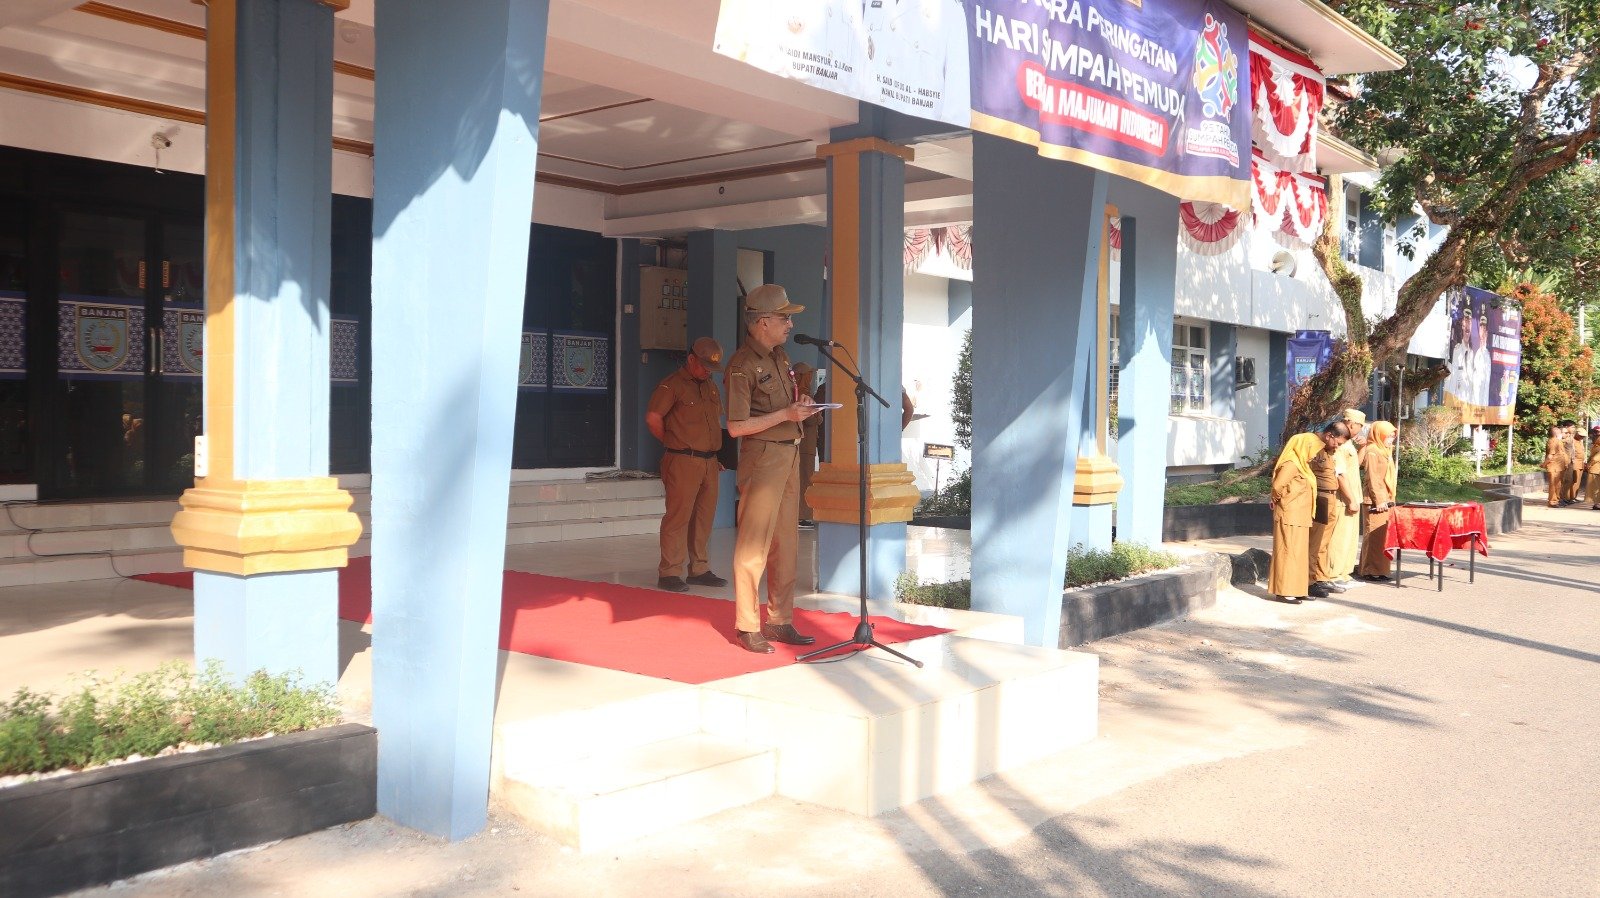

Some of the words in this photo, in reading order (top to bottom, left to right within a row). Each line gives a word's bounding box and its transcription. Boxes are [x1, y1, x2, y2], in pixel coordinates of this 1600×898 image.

[1087, 6, 1178, 75] PERINGATAN
[802, 51, 833, 68] MANSYUR,
[975, 5, 1039, 55] HARI
[1121, 67, 1186, 123] PEMUDA
[792, 61, 815, 74] BUPATI
[815, 66, 839, 81] BANJAR
[917, 87, 941, 100] HABSYIE
[911, 97, 934, 109] BANJAR
[1058, 88, 1119, 131] MAJUKAN
[1120, 107, 1164, 148] INDONESIA
[80, 307, 125, 318] BANJAR
[567, 339, 592, 347] BANJAR
